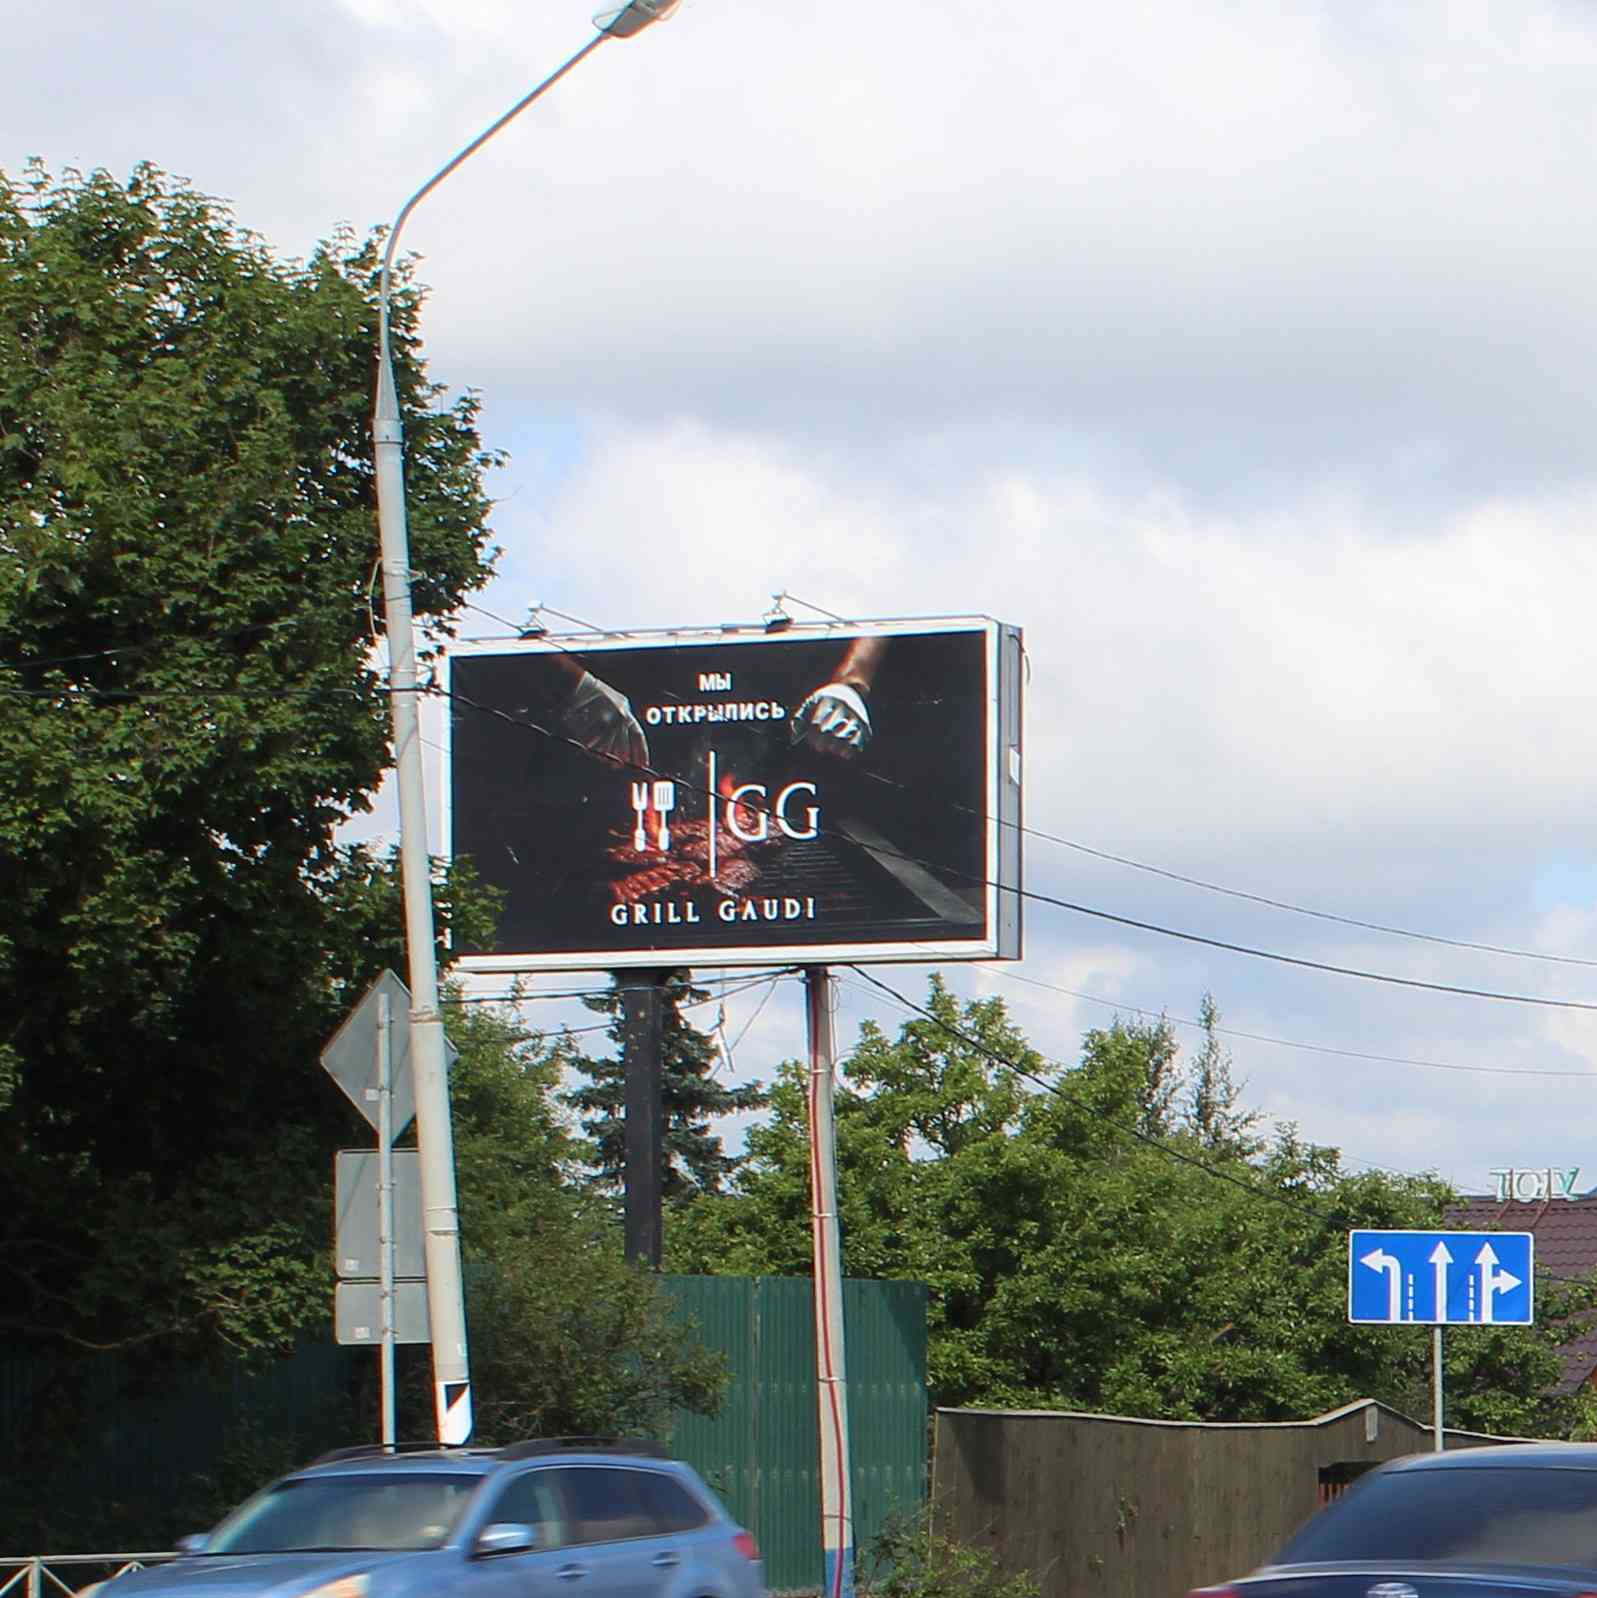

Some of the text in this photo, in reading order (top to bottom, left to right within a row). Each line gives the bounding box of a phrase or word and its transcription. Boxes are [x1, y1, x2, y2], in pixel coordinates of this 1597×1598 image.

[698, 673, 731, 692] МЫ
[646, 702, 787, 726] ОТКРЫЛИСЬ
[726, 782, 821, 843] GG
[611, 897, 816, 926] GRILL GAUDI
